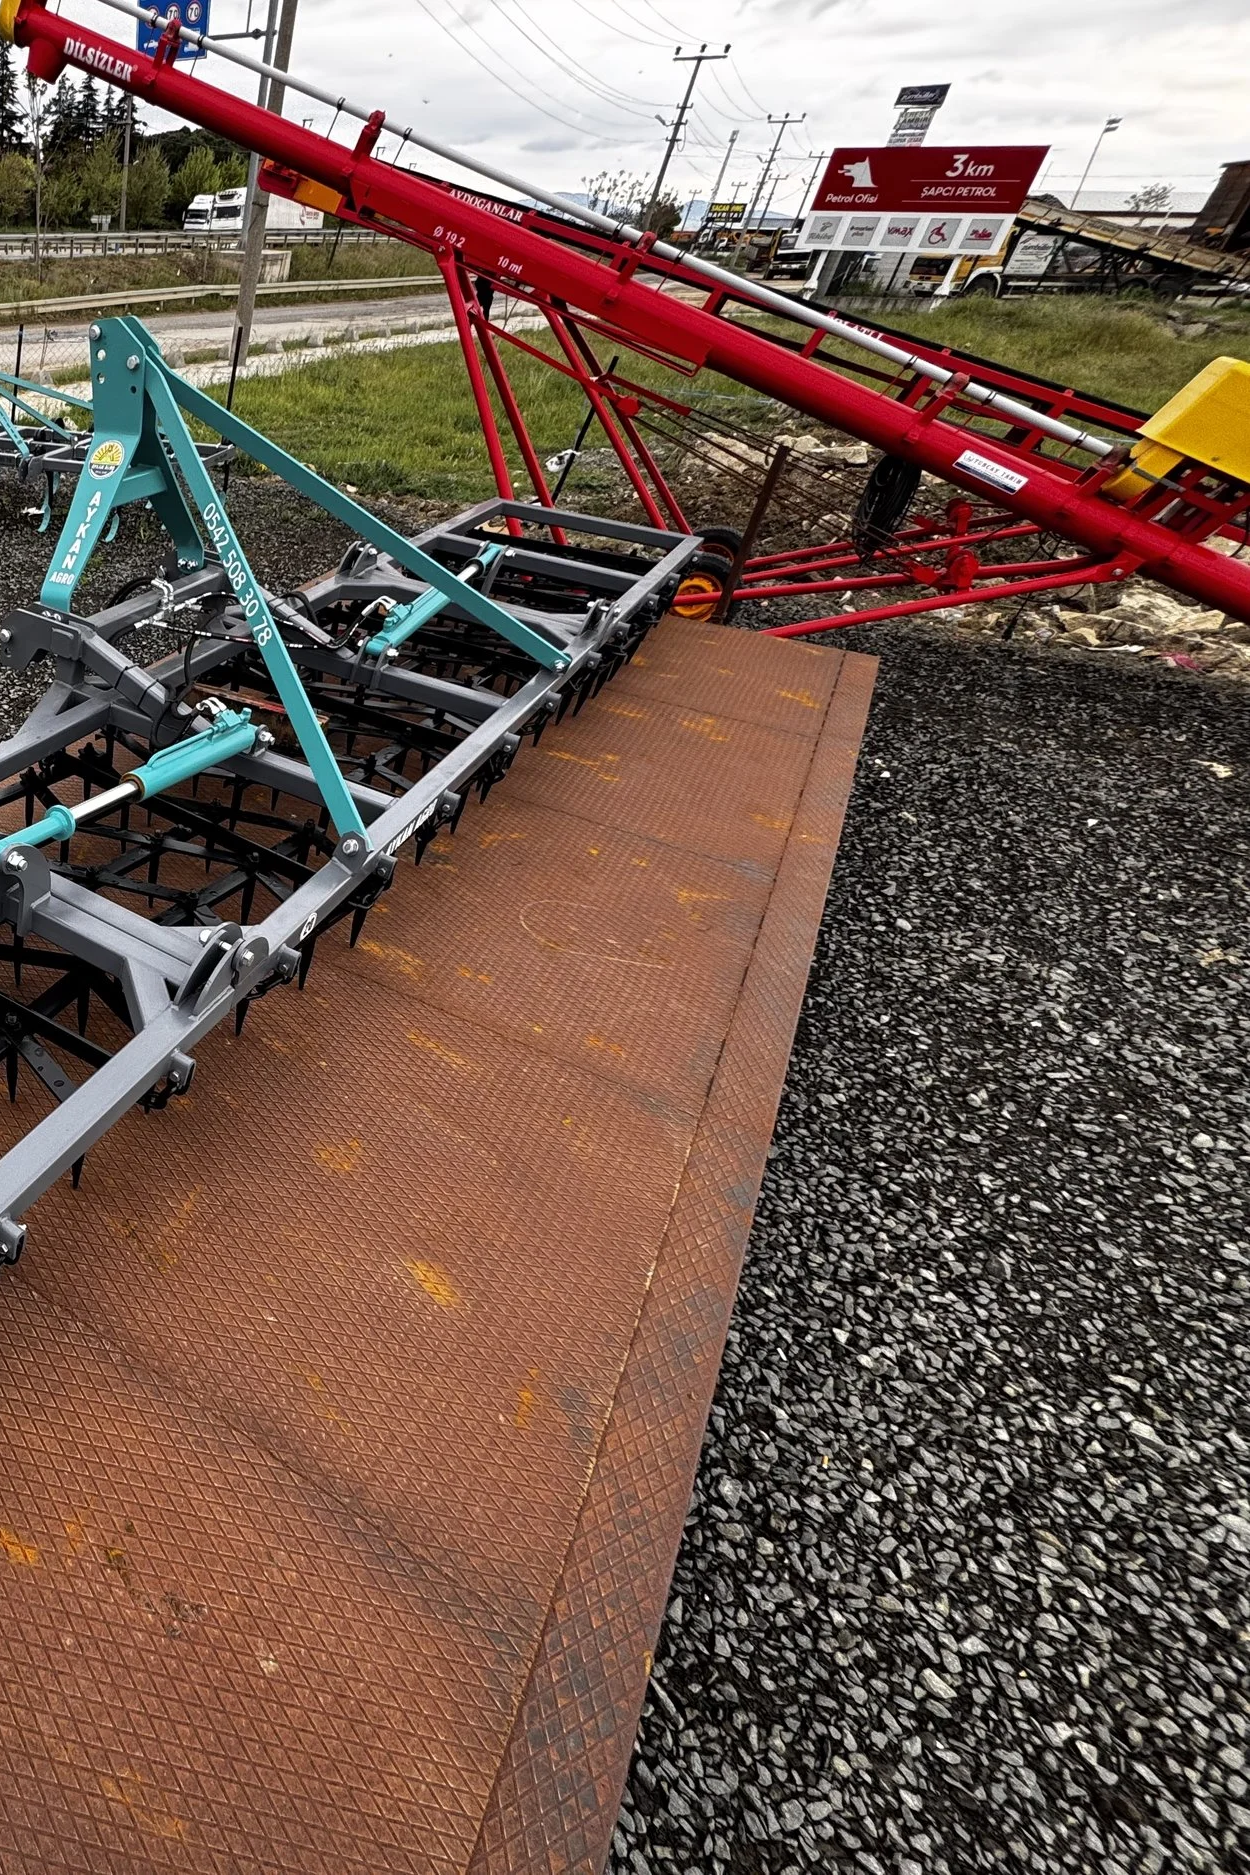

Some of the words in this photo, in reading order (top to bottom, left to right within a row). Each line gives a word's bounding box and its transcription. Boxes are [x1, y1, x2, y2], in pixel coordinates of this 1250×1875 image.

[190, 7, 199, 18] 70
[945, 154, 970, 177] 3
[965, 160, 994, 177] km
[825, 193, 853, 204] Petrol
[854, 193, 879, 204] Ofisi
[920, 186, 954, 198] ŞAPCI
[955, 187, 997, 198] PETROL
[445, 231, 466, 249] 19.2
[497, 255, 509, 268] 10
[508, 263, 523, 275] mt
[62, 490, 102, 570] AYKAN
[49, 571, 75, 586] AGRO
[203, 503, 230, 553] 0542
[223, 549, 247, 591] 508
[240, 588, 259, 617] 30
[253, 615, 273, 647] 78
